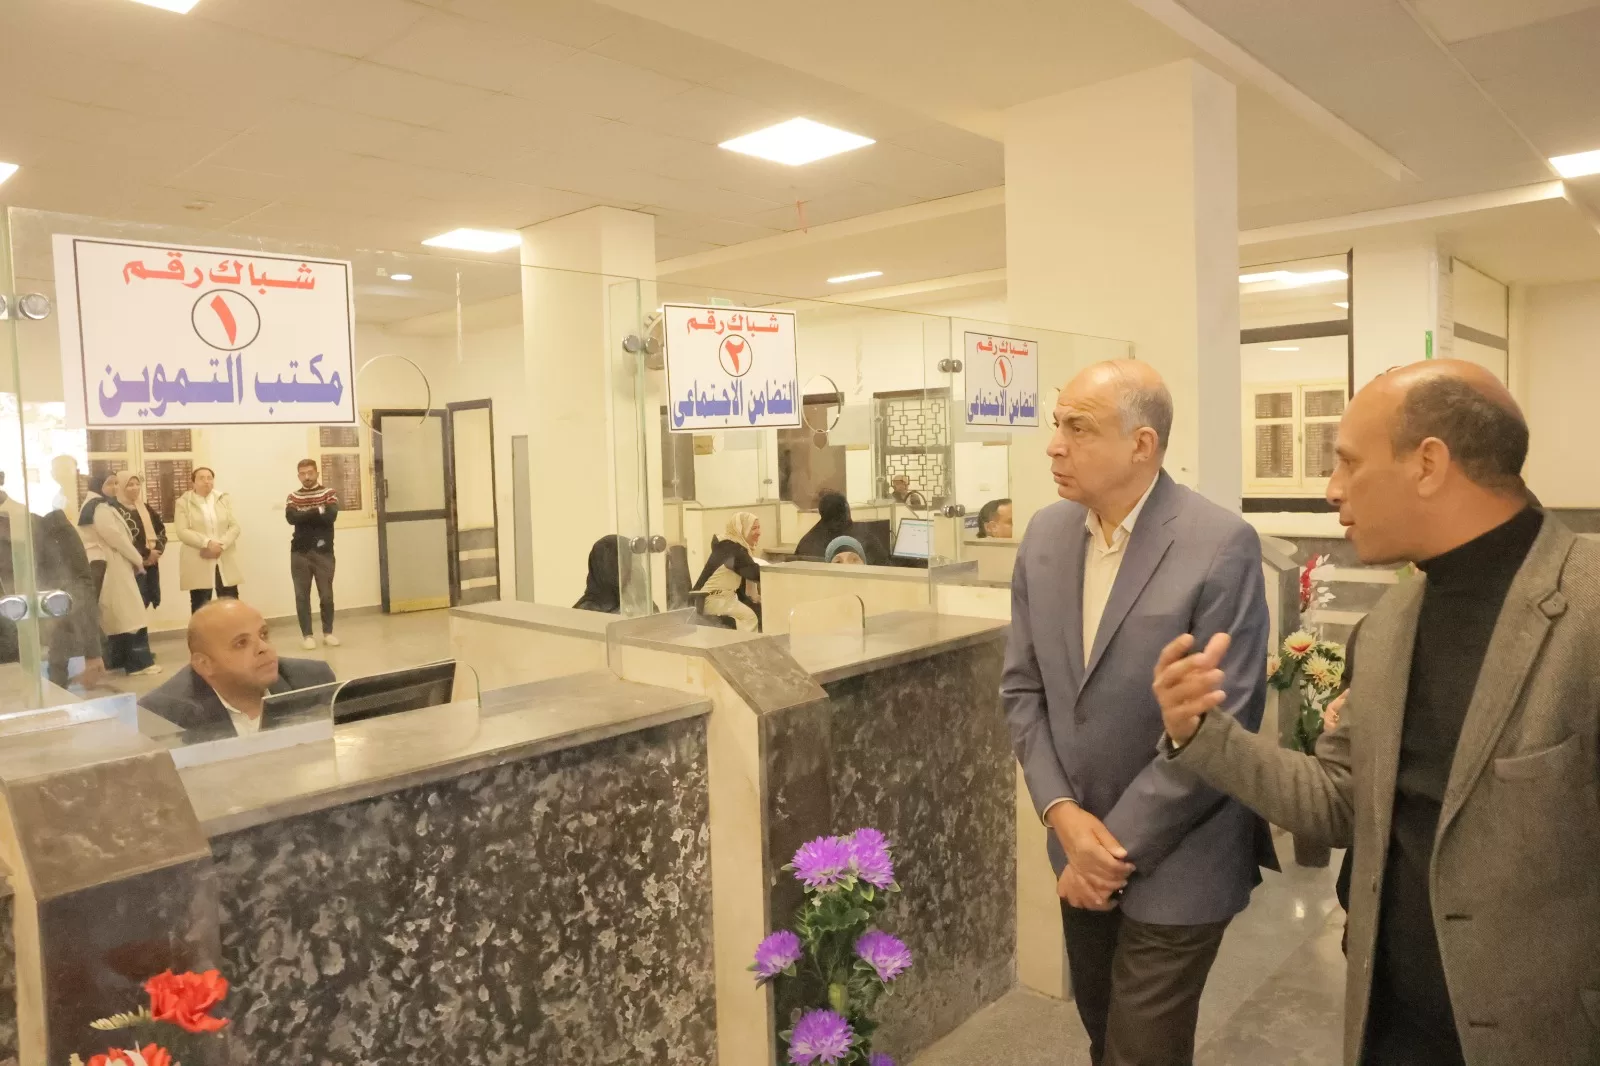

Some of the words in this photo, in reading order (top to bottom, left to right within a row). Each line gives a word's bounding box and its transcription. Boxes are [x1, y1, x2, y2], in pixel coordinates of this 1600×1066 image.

[122, 251, 204, 289] رقم
[208, 260, 316, 295] شباك
[210, 295, 237, 345] ١
[687, 310, 725, 336] رقم
[726, 313, 779, 338] شباك
[725, 340, 745, 374] ٢
[976, 337, 998, 355] رقم
[999, 341, 1029, 358] شباك
[98, 352, 244, 418] التموين
[254, 353, 344, 414] مكتب
[999, 359, 1007, 385] ١
[747, 379, 796, 425] التضامن
[1009, 390, 1037, 424] التضامن
